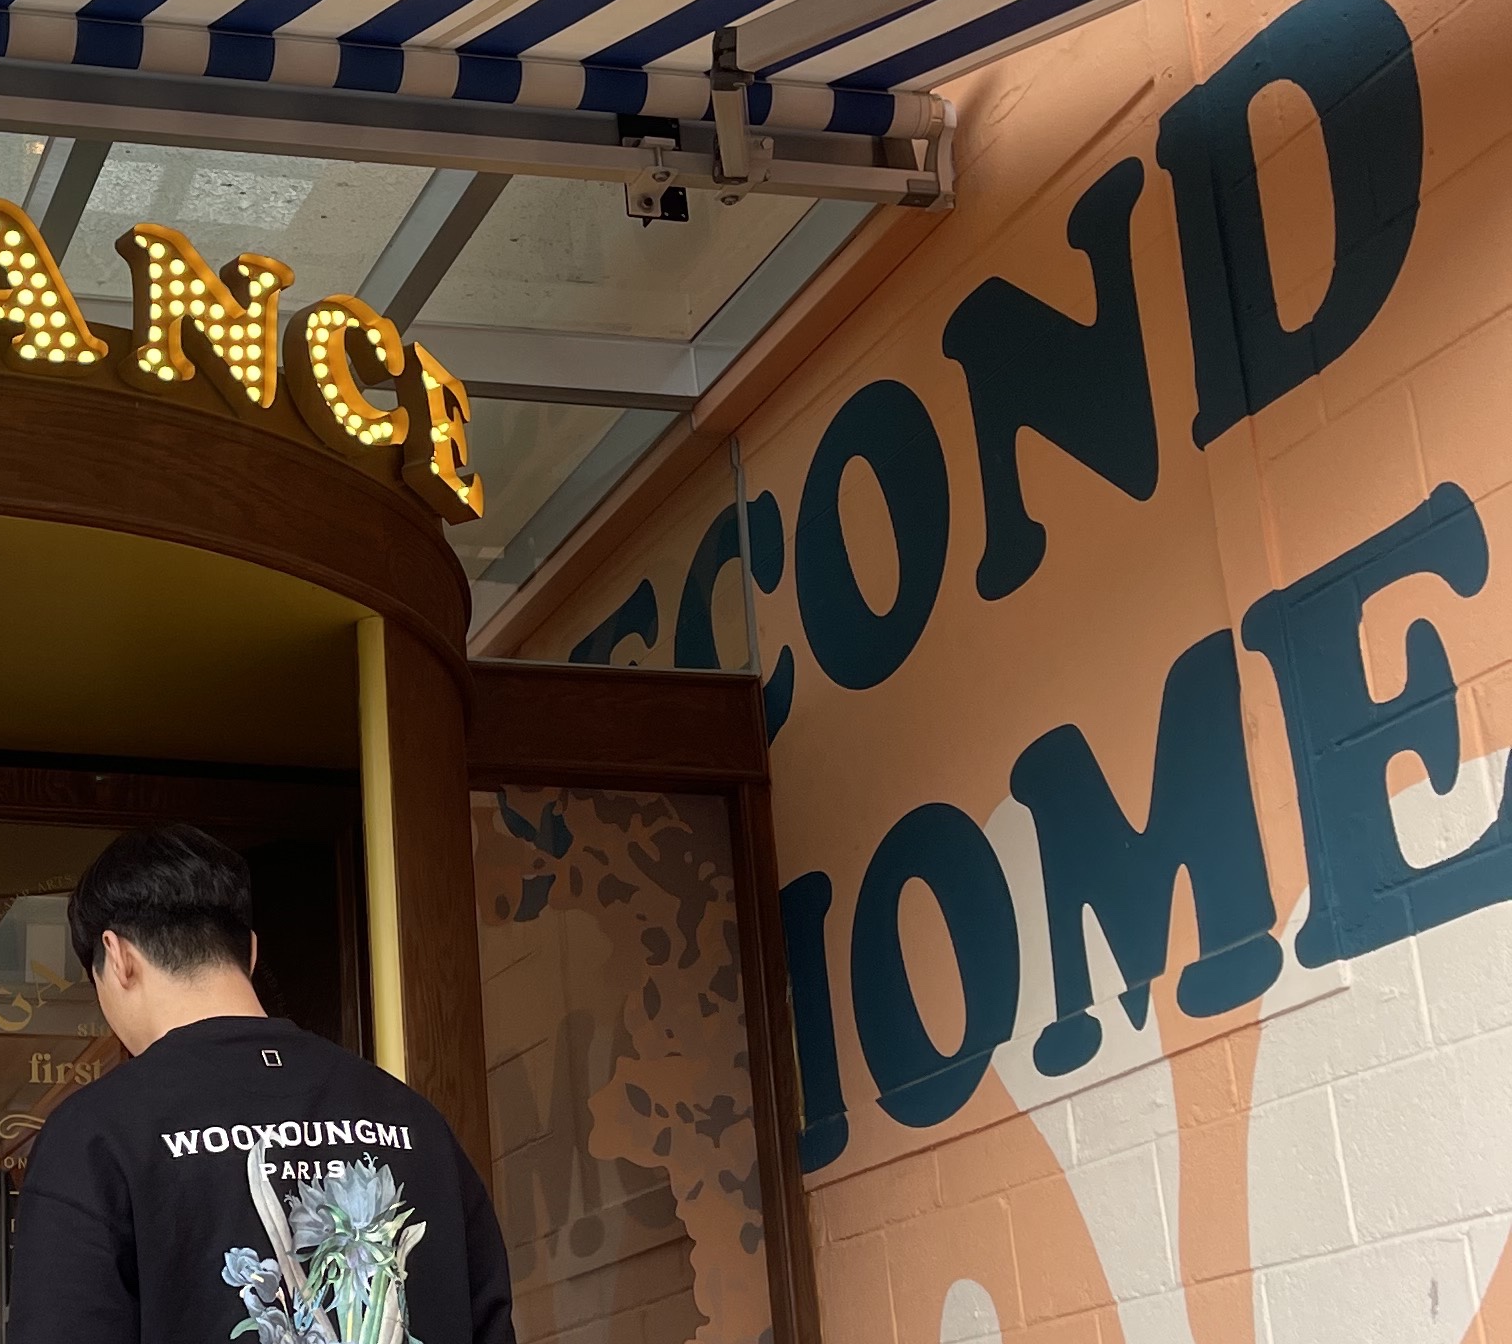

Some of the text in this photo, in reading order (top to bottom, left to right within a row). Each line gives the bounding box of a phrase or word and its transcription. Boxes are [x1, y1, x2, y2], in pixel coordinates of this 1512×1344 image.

[28, 1052, 104, 1085] first
[160, 1118, 414, 1159] WOOYOUNGMI
[259, 1160, 346, 1182] PARIS
